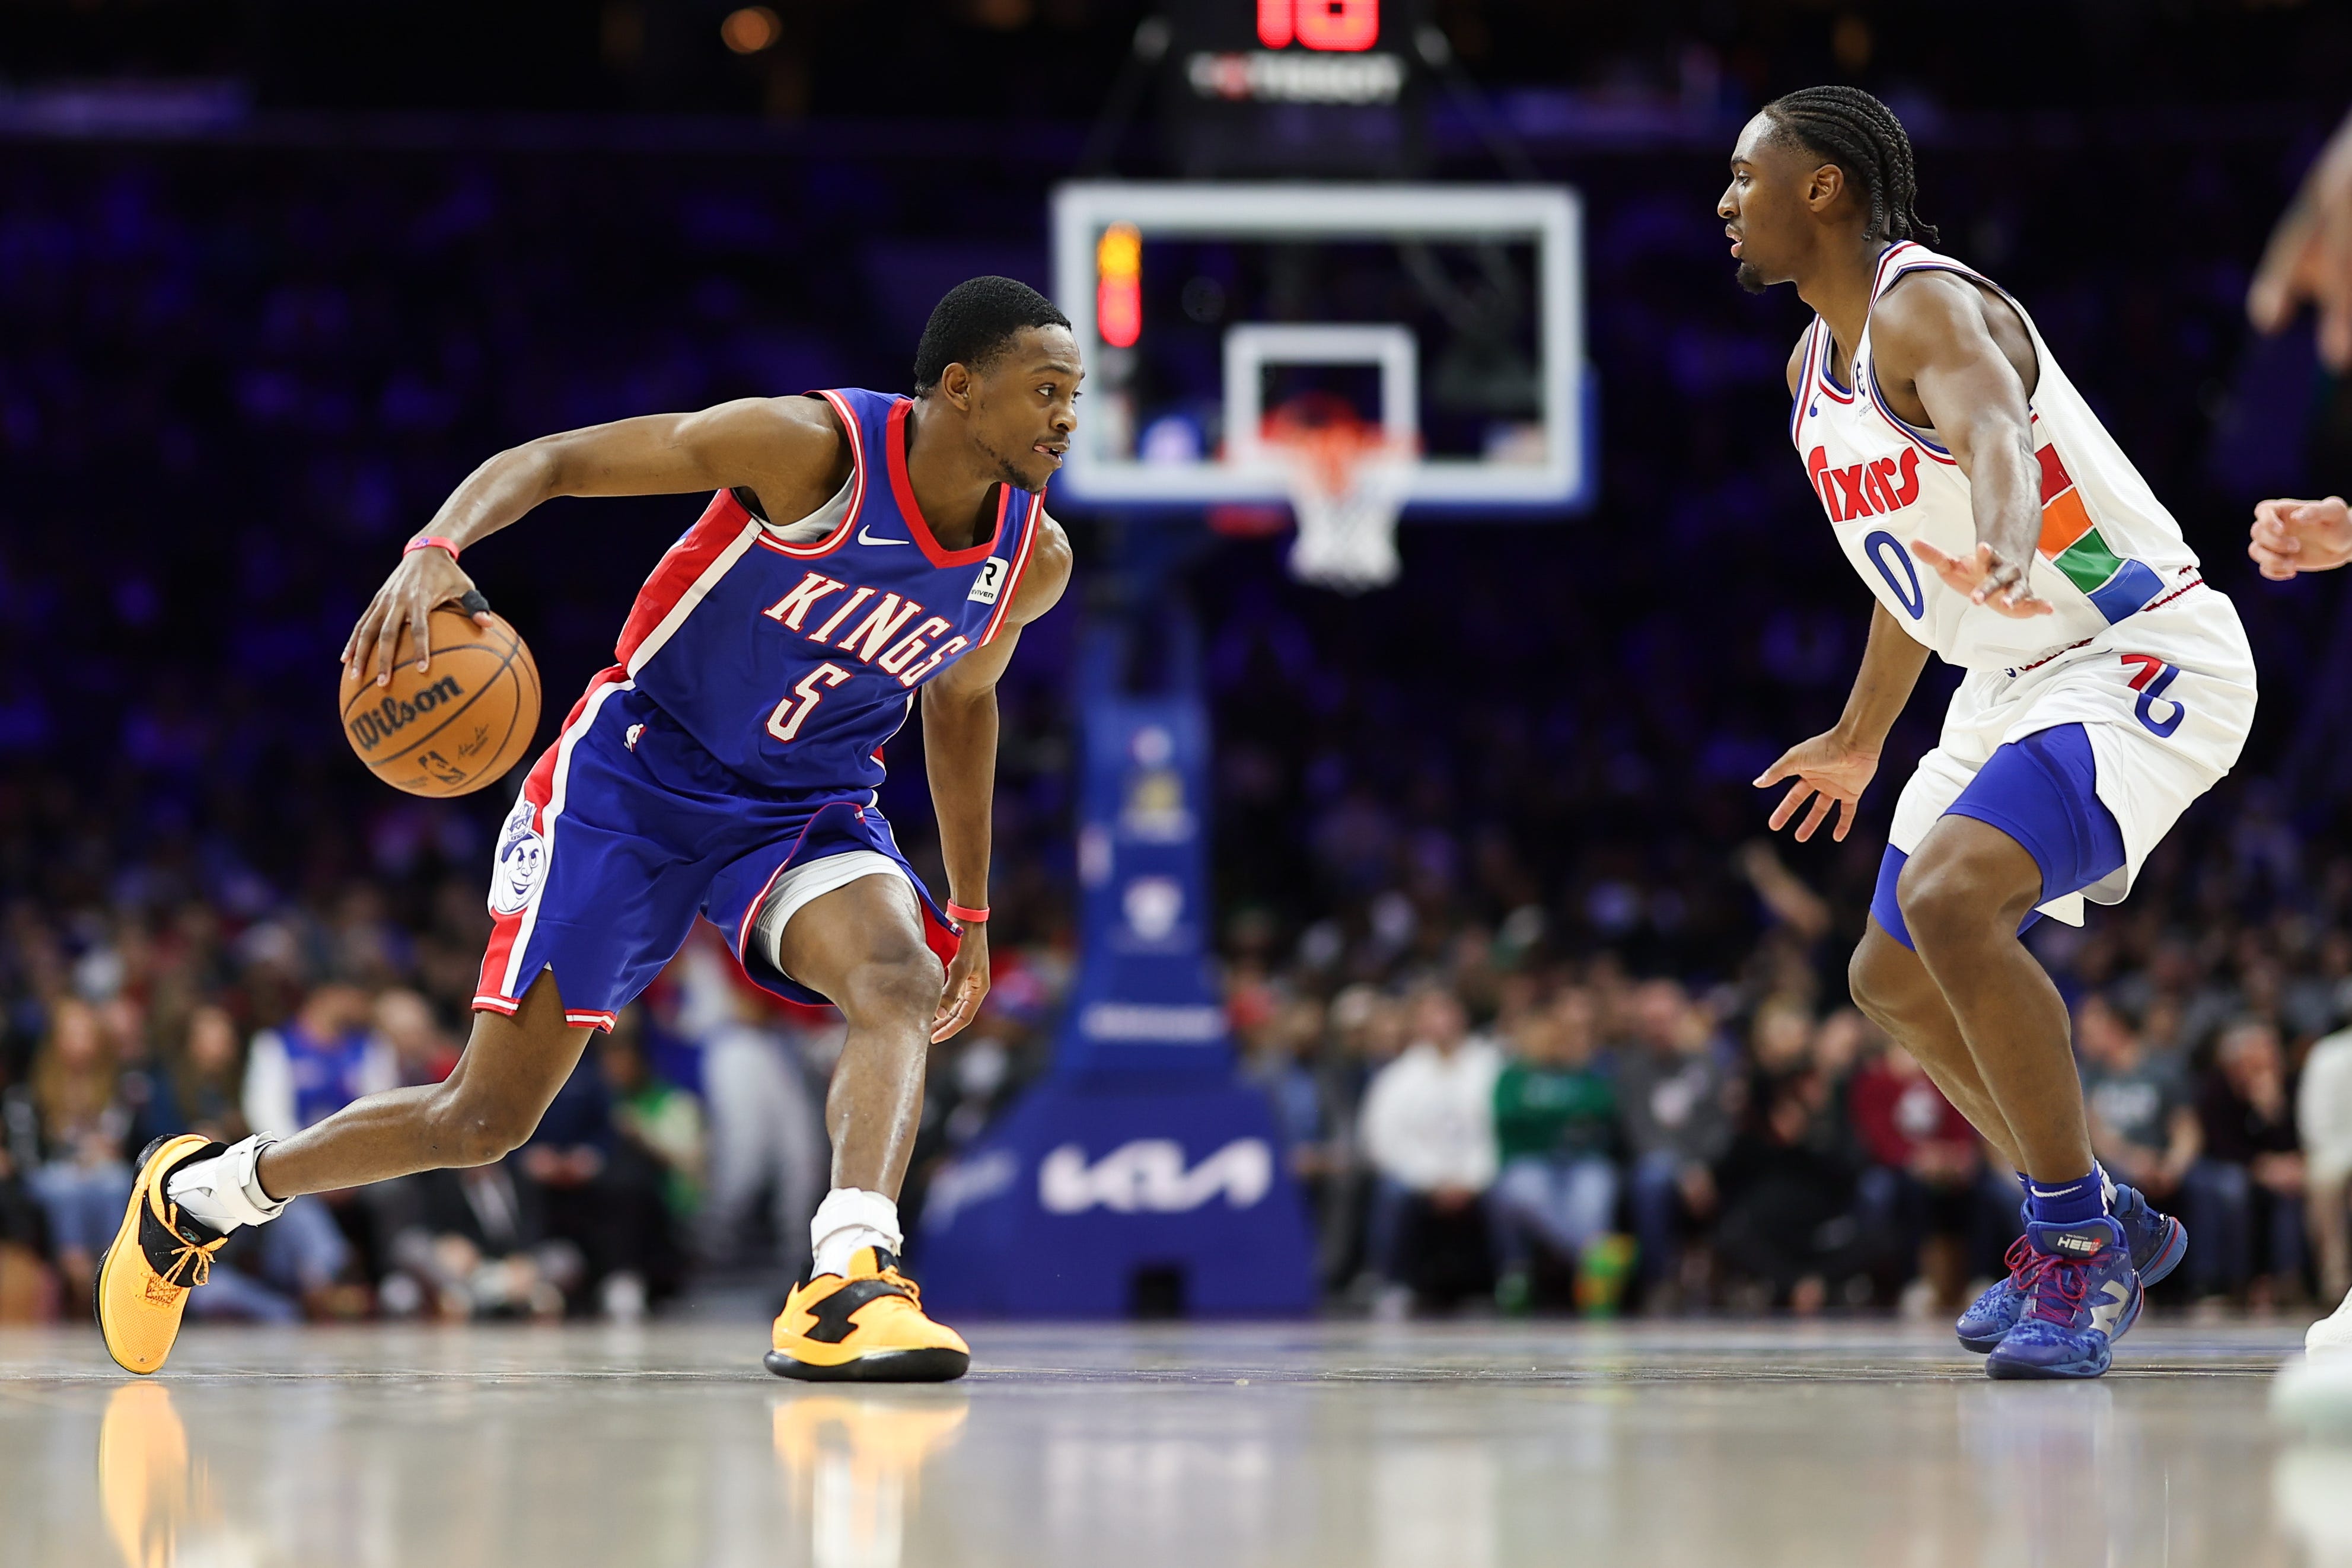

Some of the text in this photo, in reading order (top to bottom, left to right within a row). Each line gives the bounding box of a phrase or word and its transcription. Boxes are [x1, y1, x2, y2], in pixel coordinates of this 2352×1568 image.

[1864, 530, 1924, 620] 0
[761, 571, 968, 689] KINGS
[349, 675, 464, 752] Wilson
[764, 661, 854, 744] 5
